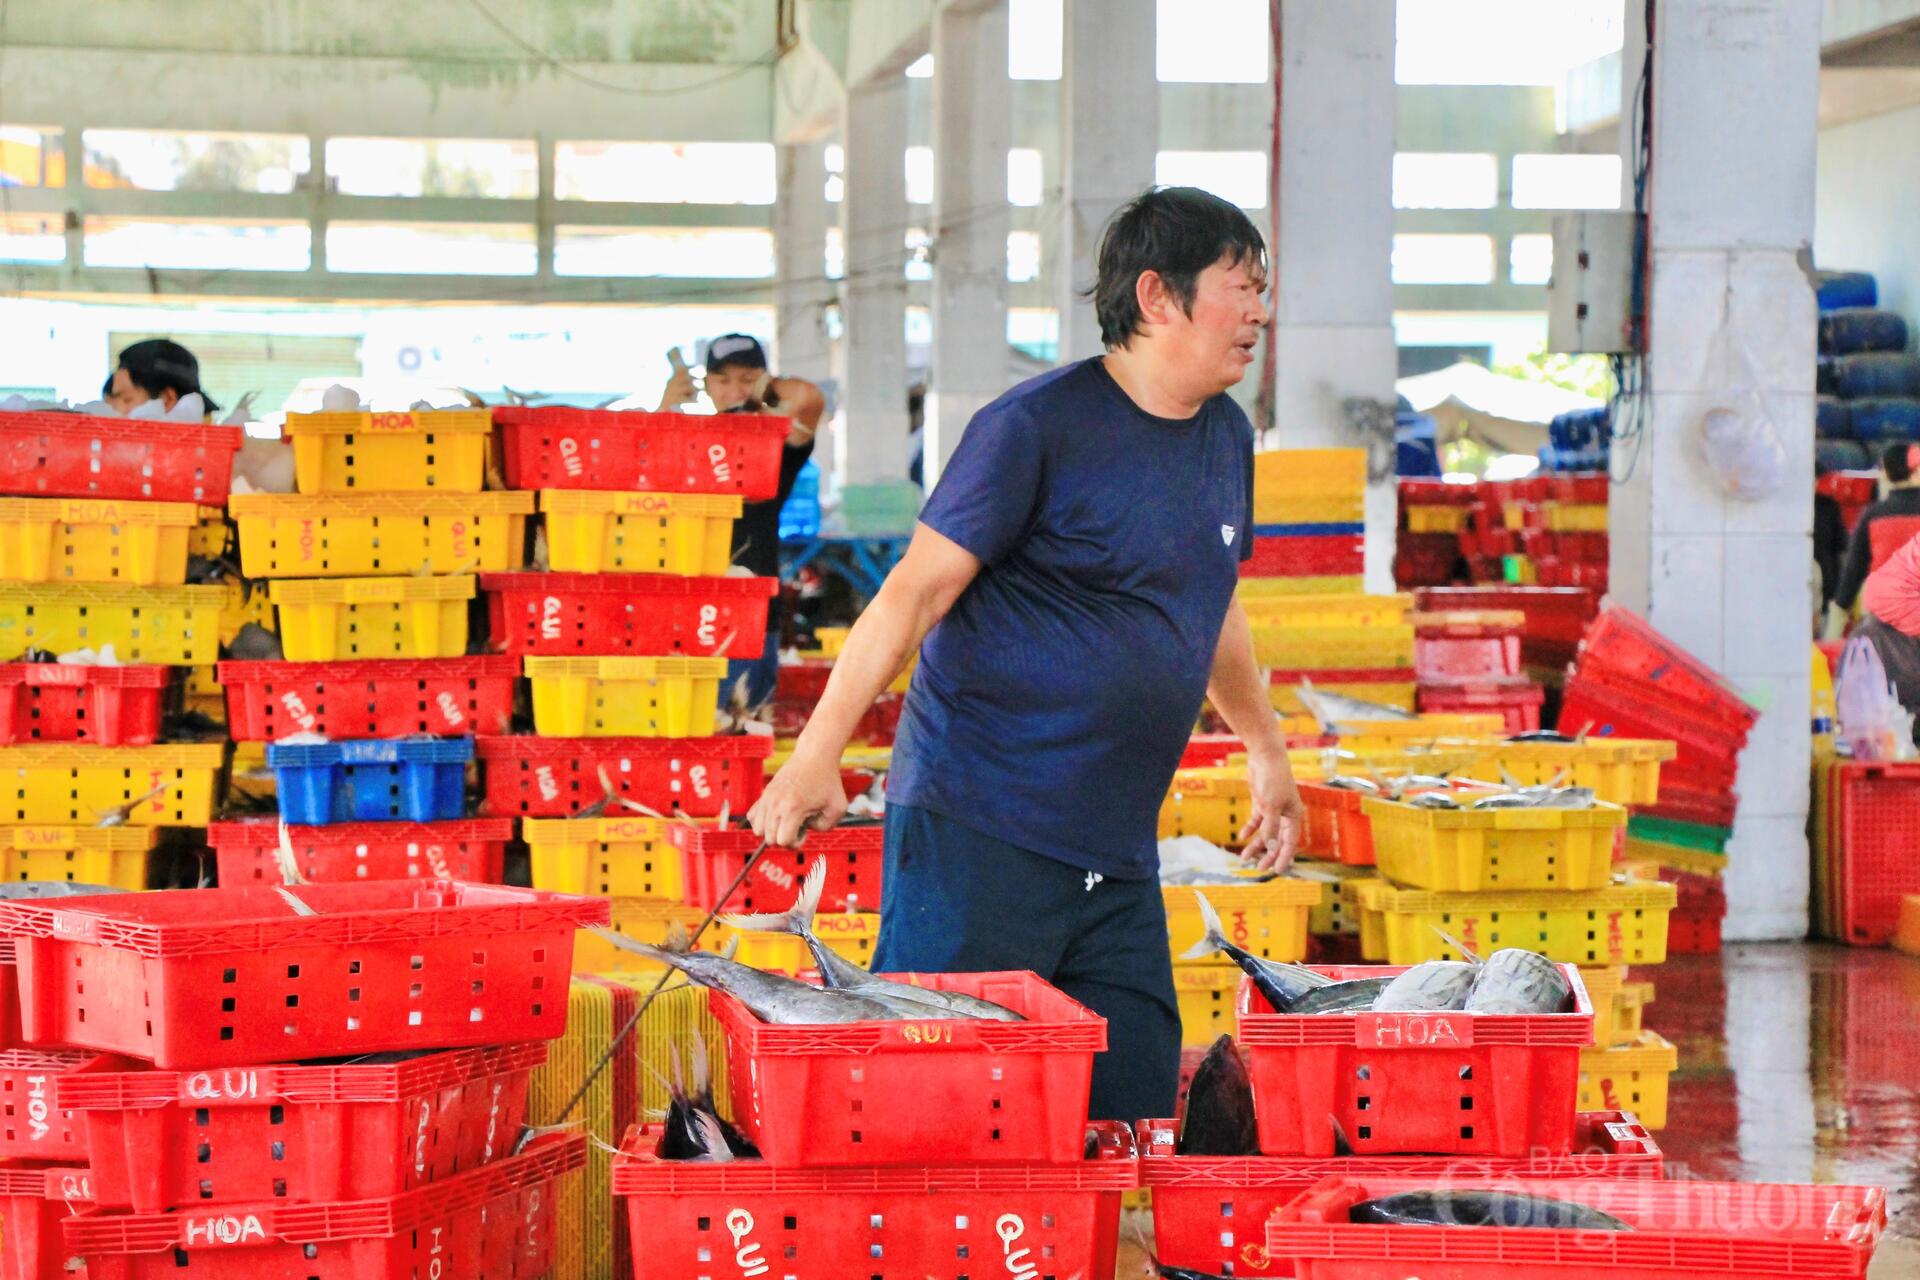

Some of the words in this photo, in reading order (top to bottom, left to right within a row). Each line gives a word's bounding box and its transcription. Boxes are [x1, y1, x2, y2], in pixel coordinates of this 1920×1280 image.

[371, 414, 414, 429] HOA
[708, 444, 730, 482] QUI
[68, 504, 119, 520] HOA
[627, 497, 669, 511] HOA
[541, 596, 561, 639] QUI
[697, 605, 717, 646] QUI
[604, 822, 647, 837] HOA
[758, 860, 793, 890] HOA
[818, 916, 867, 933] HOA
[1376, 1015, 1460, 1046] HOA
[186, 1071, 258, 1098] QUI
[26, 1075, 49, 1141] HOA
[186, 1214, 265, 1245] HOA
[726, 1208, 769, 1277] QUI
[995, 1213, 1039, 1280] QUI
